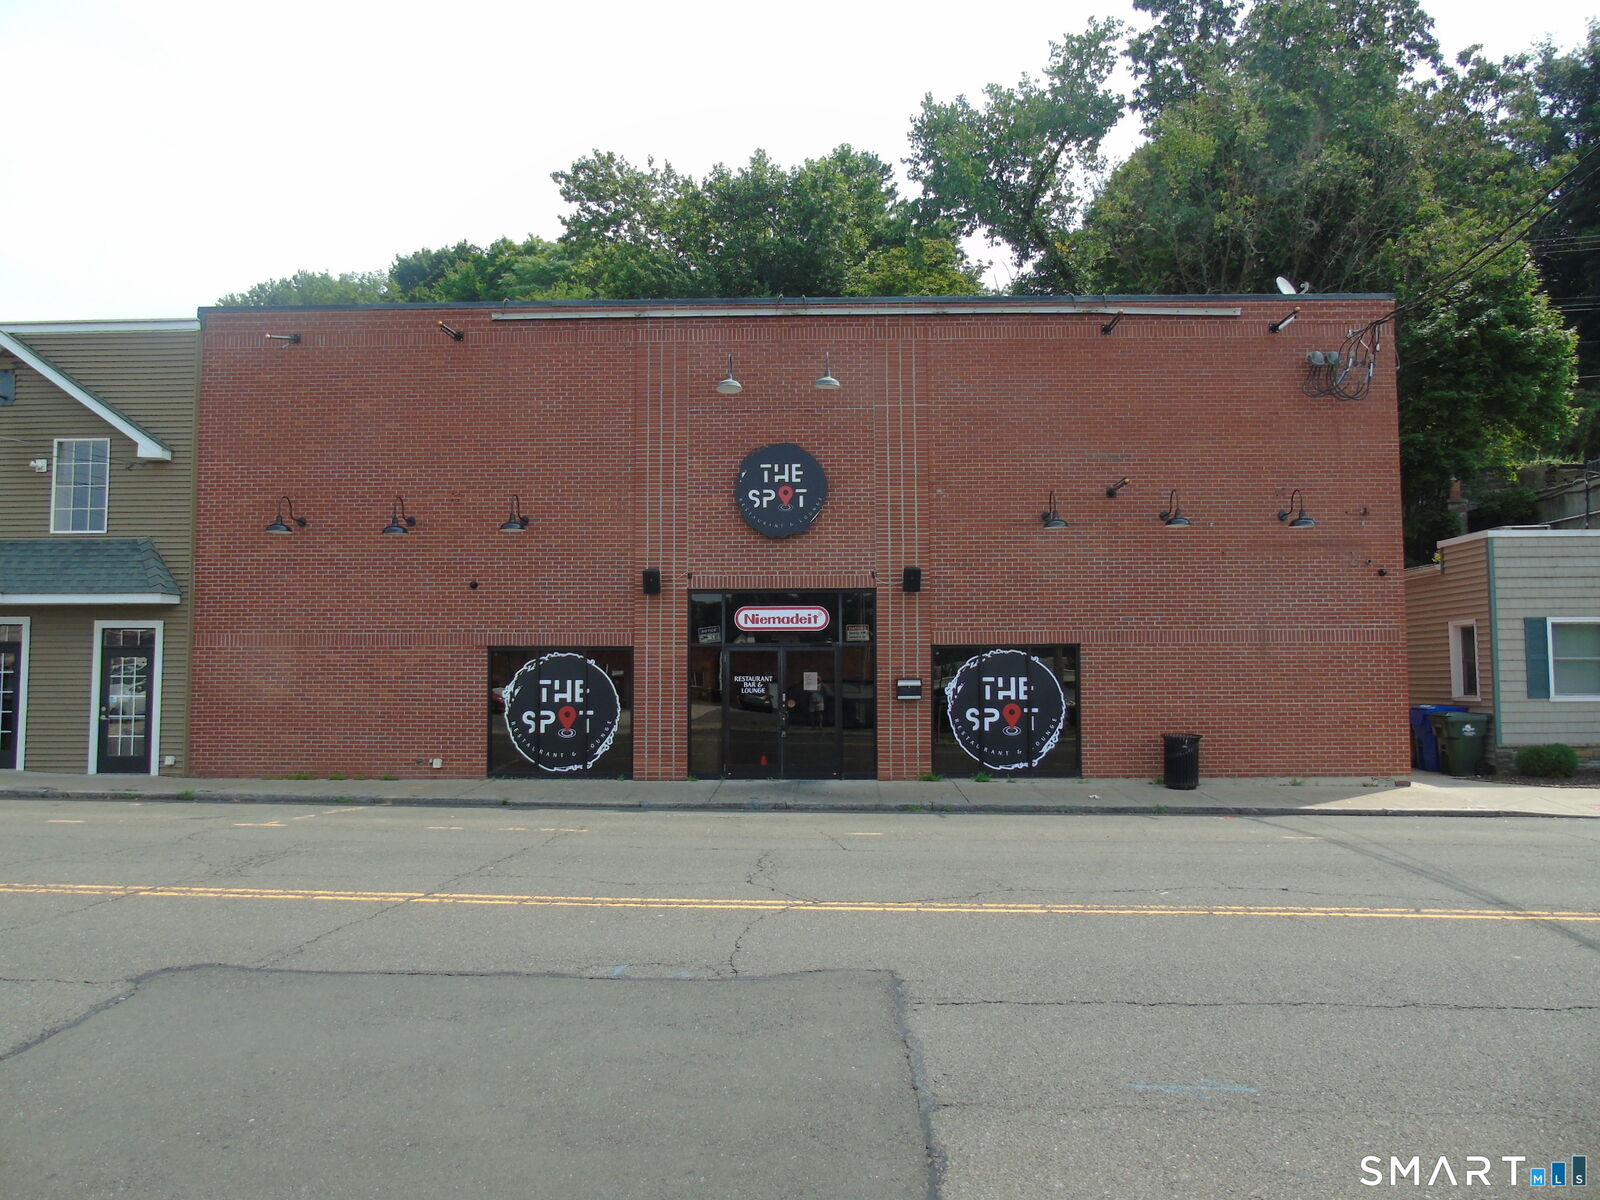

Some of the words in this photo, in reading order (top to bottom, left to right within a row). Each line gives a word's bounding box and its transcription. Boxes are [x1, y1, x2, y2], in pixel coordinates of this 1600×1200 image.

[760, 464, 803, 483] THE
[748, 486, 807, 508] SPOT
[743, 613, 819, 624] Niemadeit
[539, 680, 590, 702] THE
[982, 677, 1034, 700] THE
[587, 720, 613, 752] OUNGE
[1032, 717, 1057, 750] OUNGE
